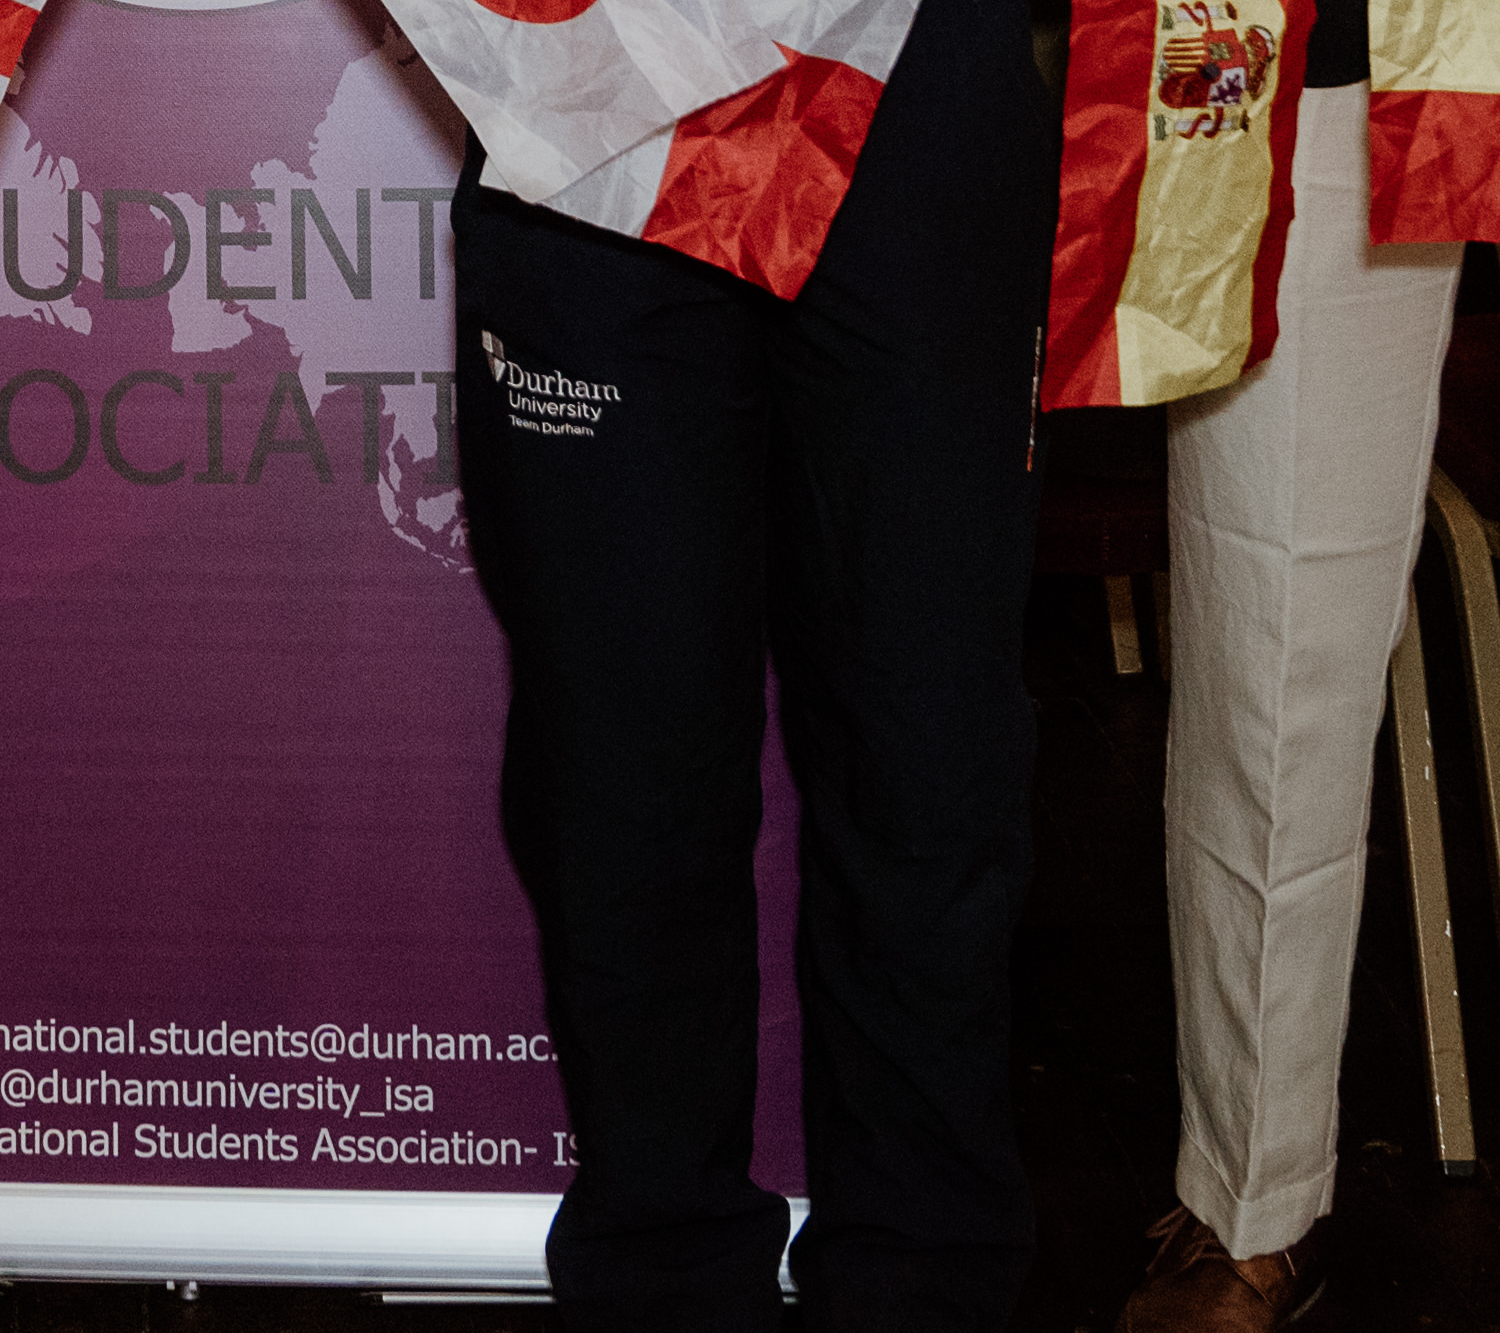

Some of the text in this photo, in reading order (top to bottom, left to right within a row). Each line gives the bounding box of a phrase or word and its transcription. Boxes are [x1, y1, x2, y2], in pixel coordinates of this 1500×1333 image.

[506, 359, 622, 403] Durham
[508, 389, 602, 423] University
[508, 413, 595, 438] Team Durham
[0, 1067, 434, 1119] @durhamuniversity_isa
[135, 1122, 298, 1162] Students
[311, 1126, 538, 1166] Association-
